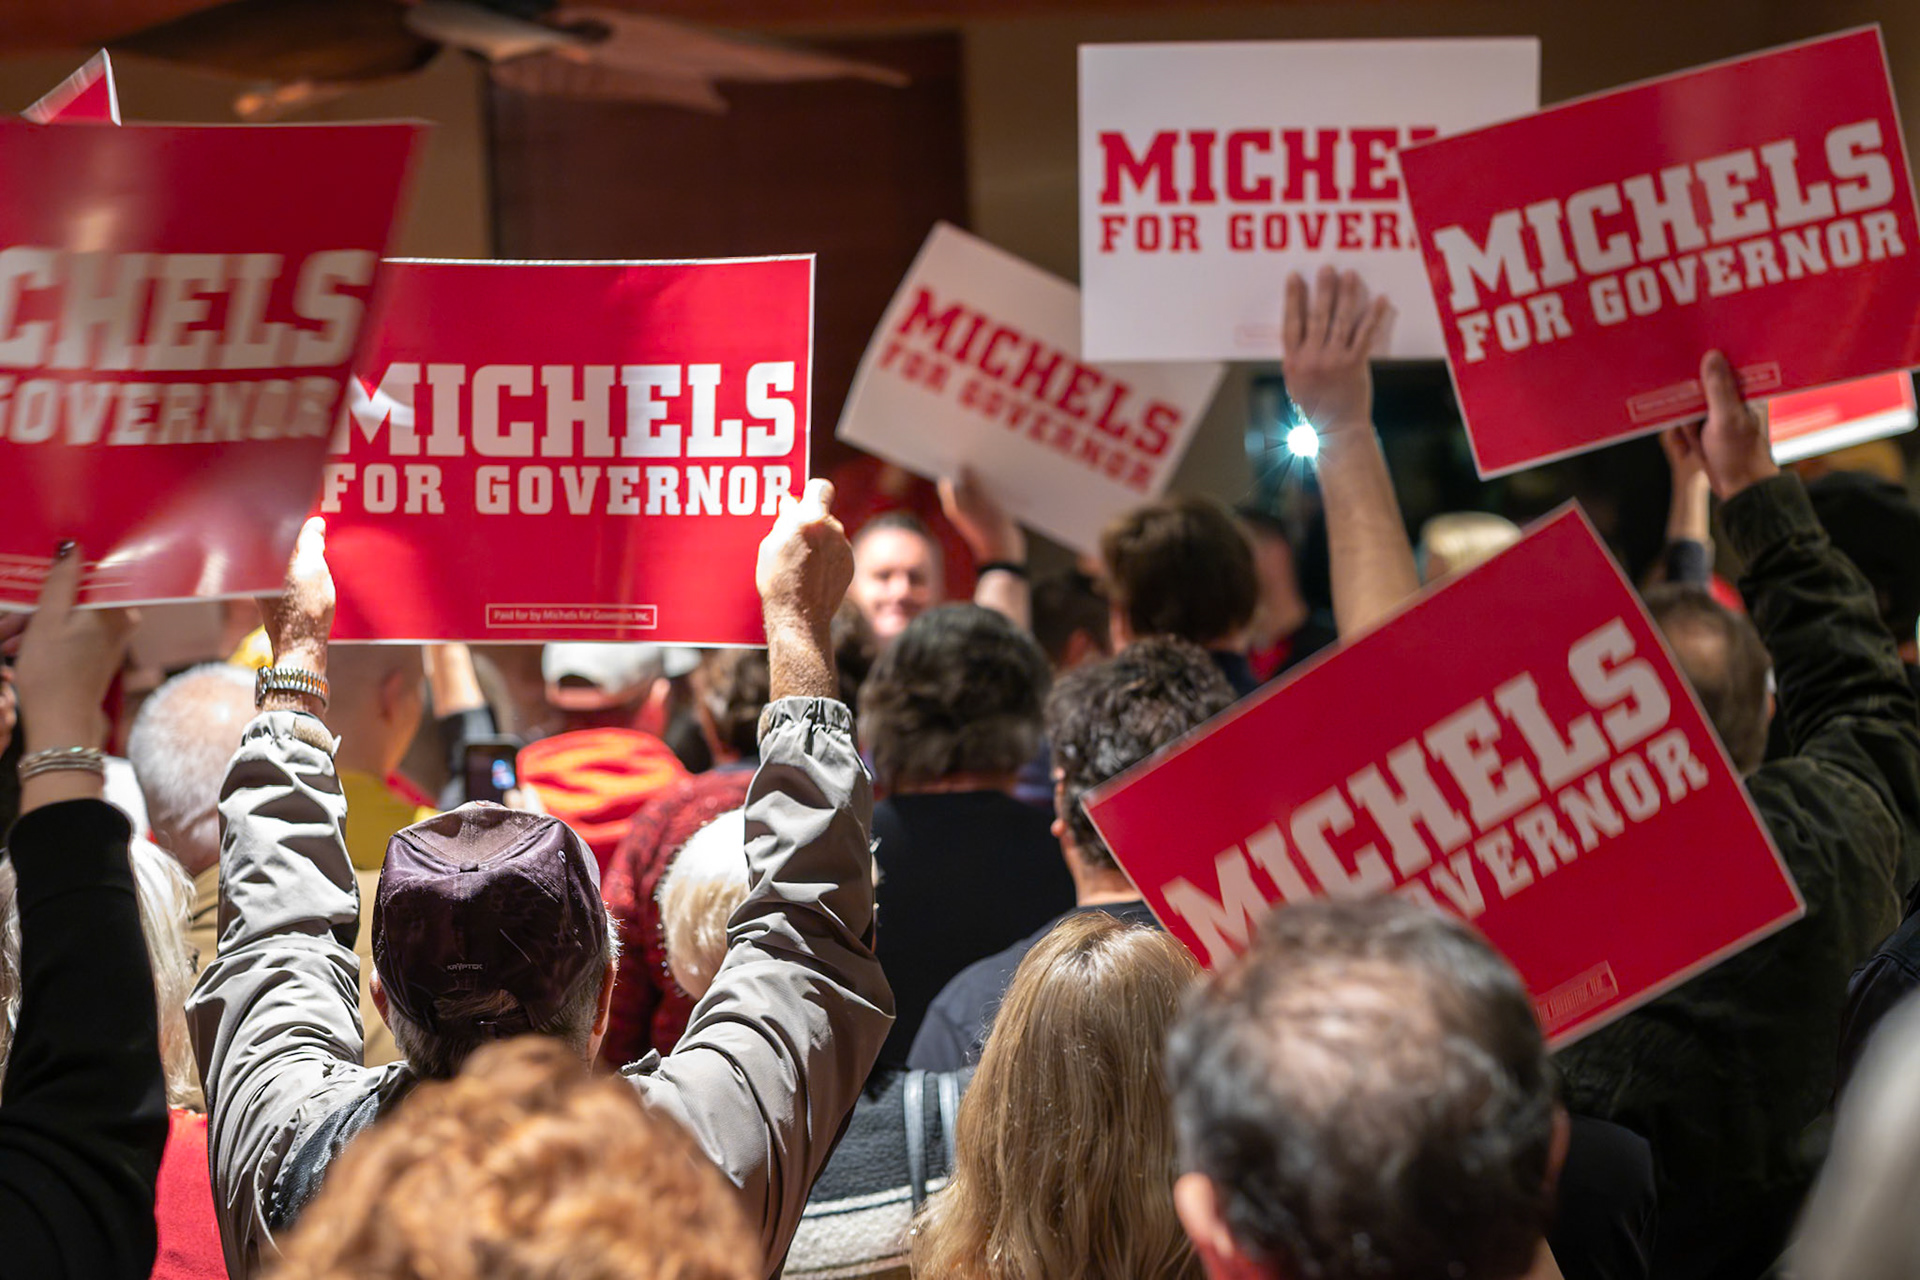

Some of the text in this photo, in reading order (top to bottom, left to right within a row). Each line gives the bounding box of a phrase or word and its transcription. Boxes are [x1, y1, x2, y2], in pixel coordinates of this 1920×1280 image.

[1097, 126, 1438, 205] MICHE
[1099, 211, 1418, 253] FOR GOVER
[1433, 120, 1896, 313] MICHELS
[1457, 210, 1907, 363] FOR GOVERNOR
[331, 362, 795, 459] MICHELS
[878, 342, 1159, 495] FOR GOVERNOR
[896, 286, 1183, 458] MICHELS
[321, 463, 792, 516] FOR GOVERNOR
[1159, 616, 1671, 969] MICHELS
